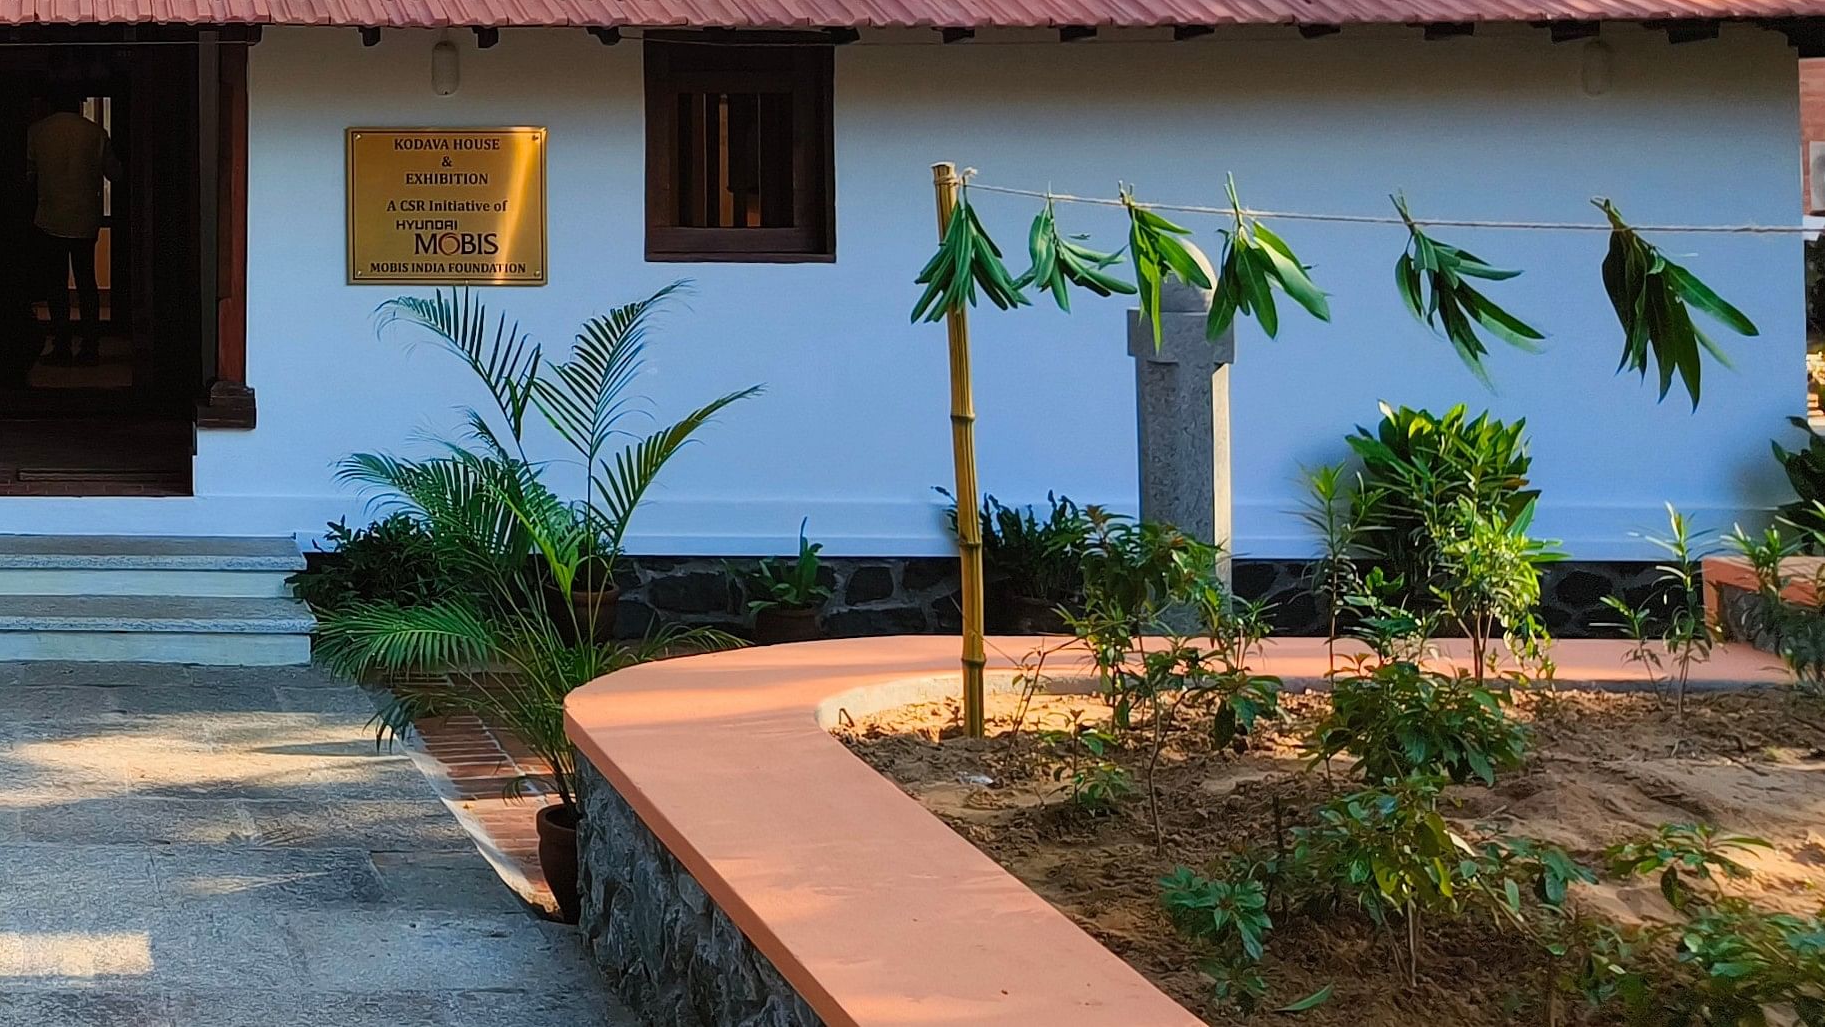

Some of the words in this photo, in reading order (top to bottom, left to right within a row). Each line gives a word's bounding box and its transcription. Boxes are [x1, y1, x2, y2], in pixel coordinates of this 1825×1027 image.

[394, 138, 449, 150] KODAVA
[453, 138, 500, 150] HOUSE
[441, 156, 453, 167] &
[405, 173, 488, 185] EXHIBITION
[387, 200, 396, 212] A
[400, 200, 425, 212] CSR
[429, 200, 490, 212] Initiative
[494, 200, 508, 212] of
[396, 220, 458, 230] HYUNDAI
[414, 232, 499, 256] MOBIS
[370, 263, 409, 273] MOBIS
[411, 263, 445, 273] INDIA
[448, 262, 526, 274] FOUNDATION
